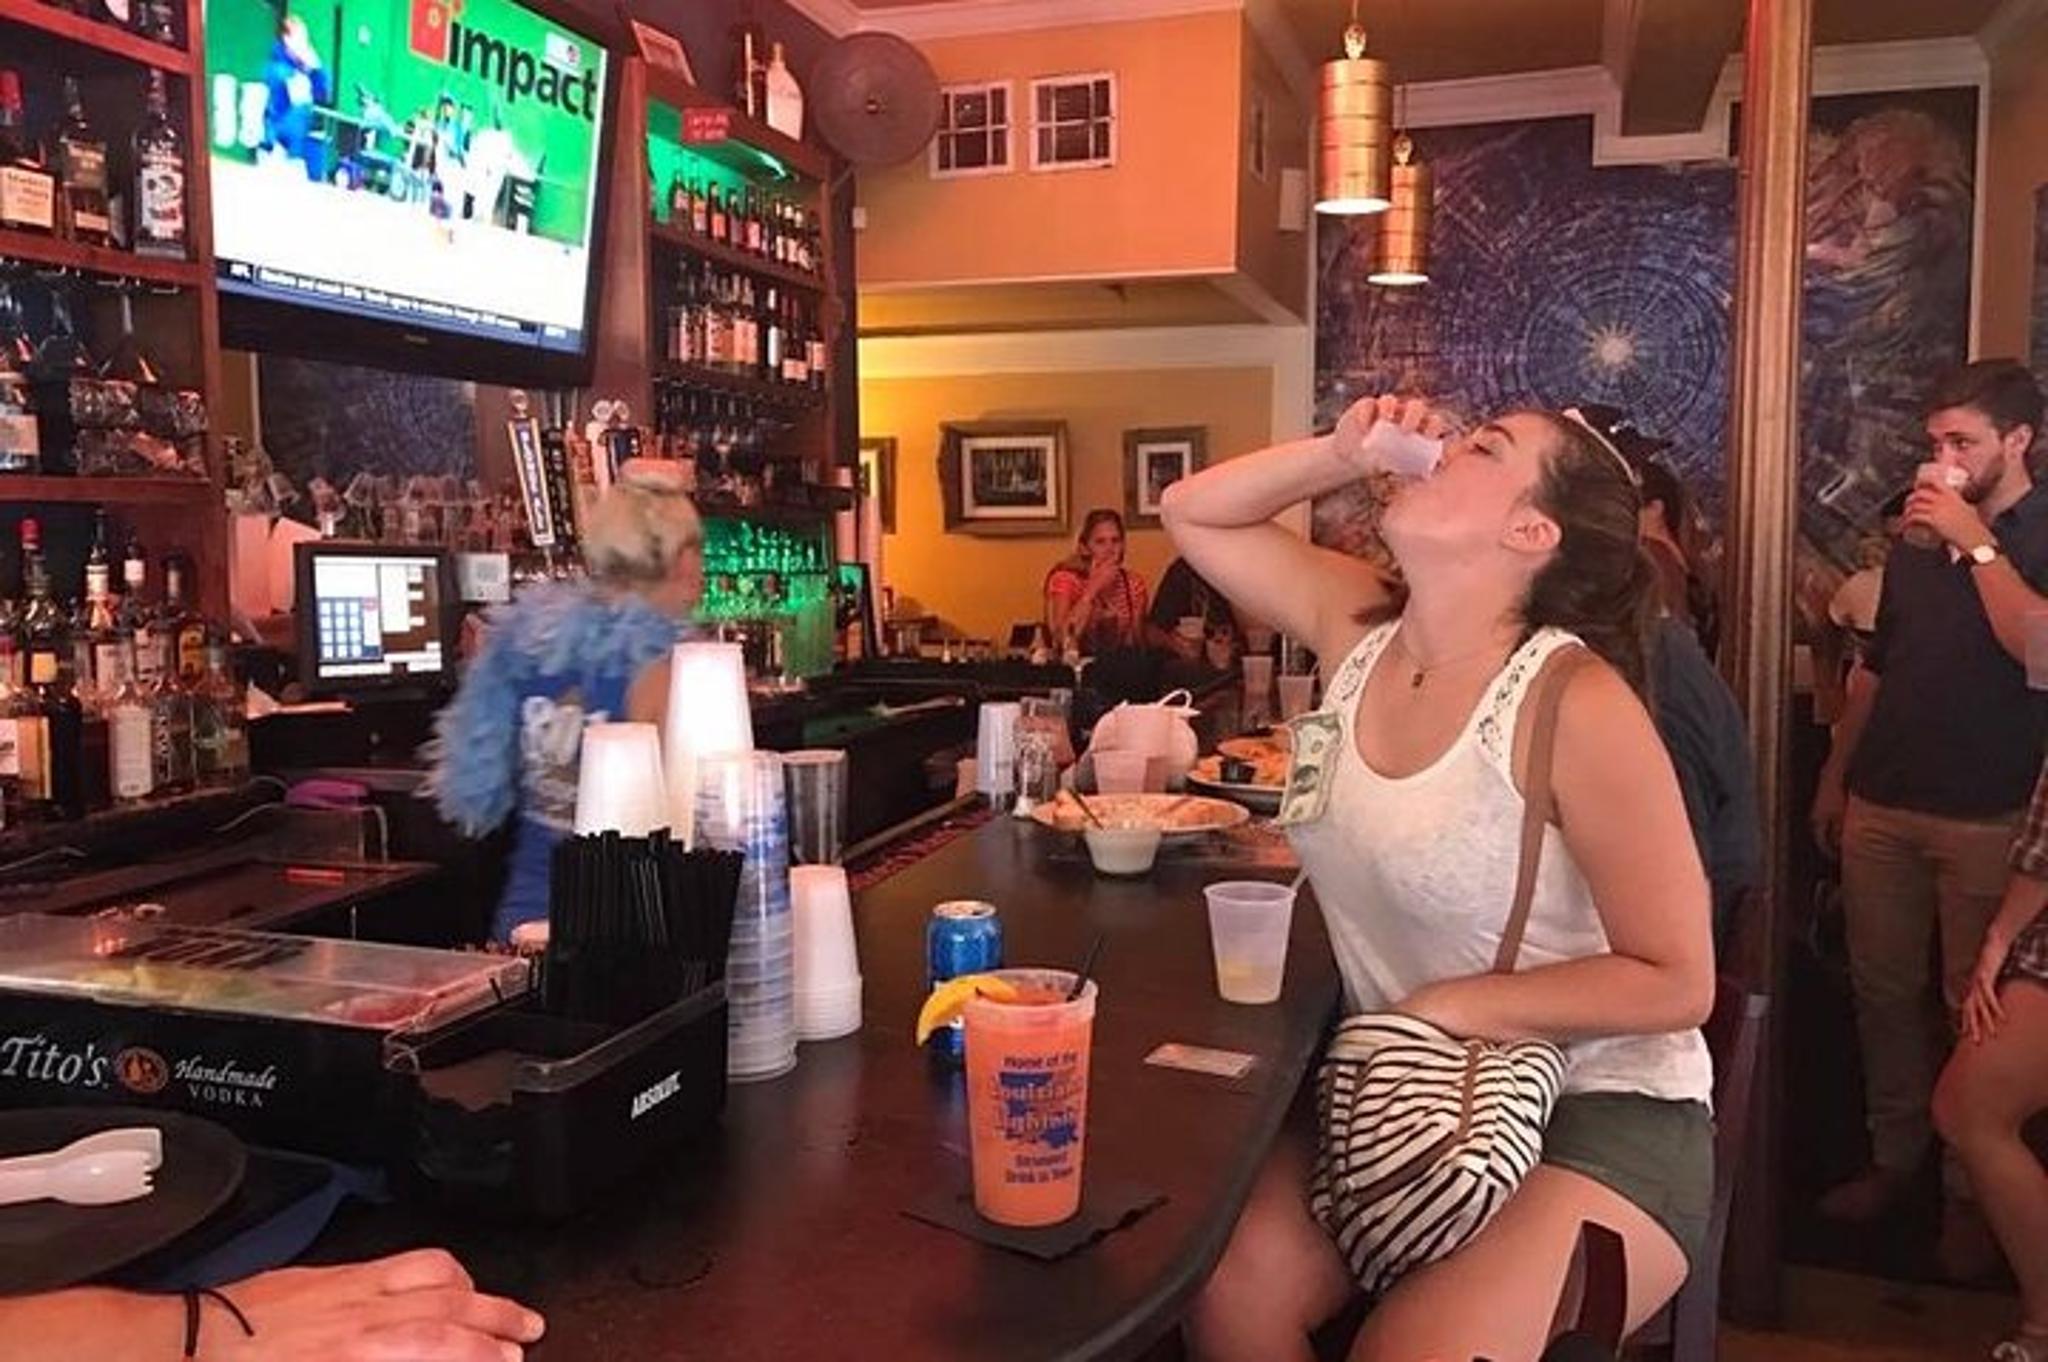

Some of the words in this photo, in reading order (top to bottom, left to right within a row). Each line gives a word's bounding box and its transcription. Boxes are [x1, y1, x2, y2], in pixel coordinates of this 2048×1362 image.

[448, 12, 597, 121] impact
[1, 1034, 109, 1087] Tito's
[174, 1055, 278, 1090] Handmade
[187, 1084, 264, 1108] VODKA
